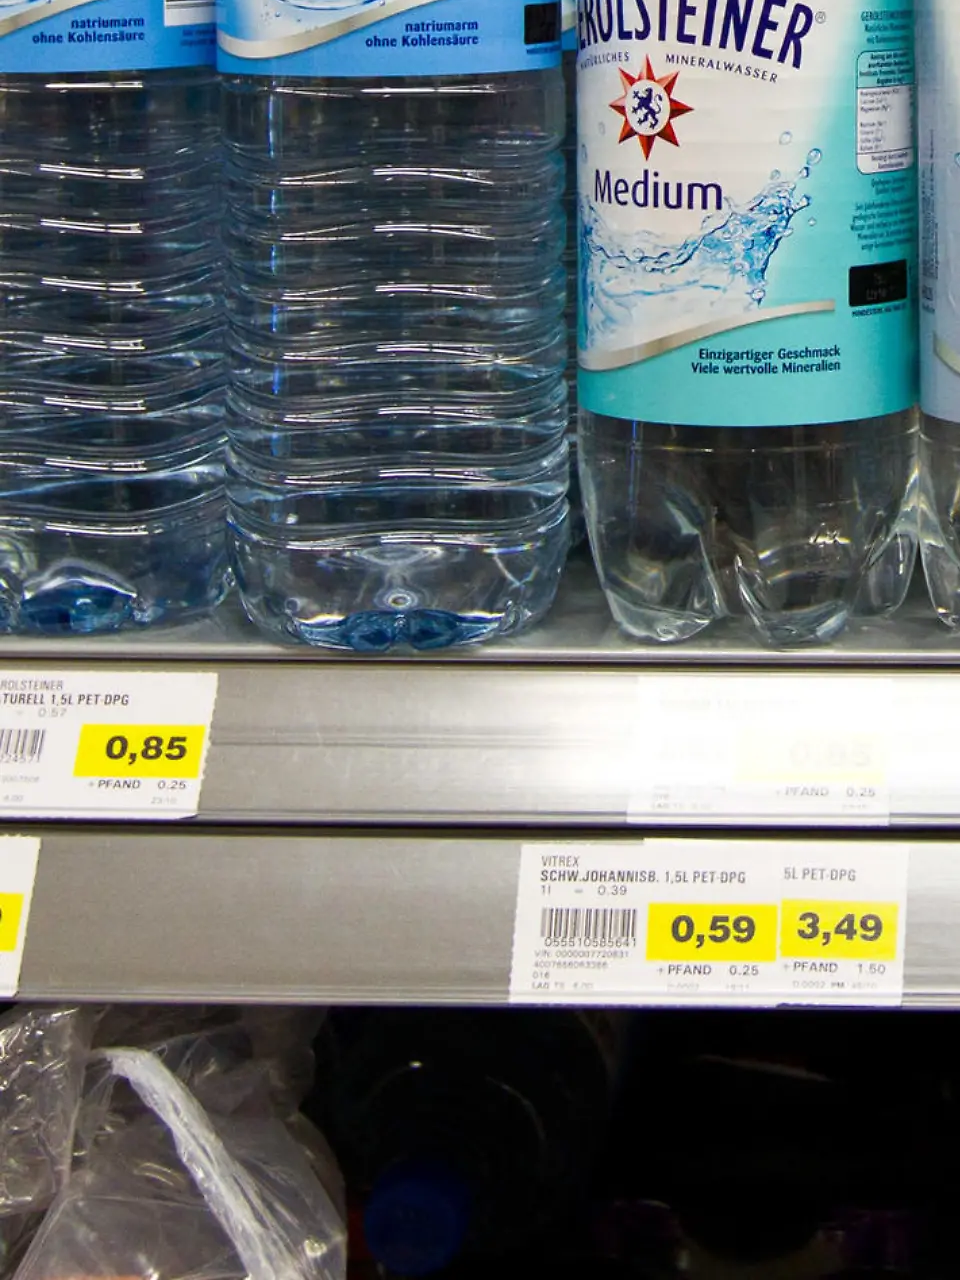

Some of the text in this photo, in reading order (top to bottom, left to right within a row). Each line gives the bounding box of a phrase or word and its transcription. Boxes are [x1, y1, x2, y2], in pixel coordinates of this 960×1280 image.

[71, 15, 145, 29] natriumarm
[404, 20, 479, 33] natriumarm
[32, 30, 145, 44] ohne Kohlensäure
[365, 34, 479, 48] ohne Kohlensäure
[665, 54, 778, 83] MINERALWASSER
[594, 170, 723, 210] Medium
[699, 345, 841, 363] Einzigartiger Geschmack
[691, 360, 841, 375] Viele wertvolle Mineralien
[105, 735, 188, 766] 0,85
[97, 780, 187, 790] PFAND 0.25
[785, 786, 876, 798] PFAND 0.25
[541, 855, 580, 867] VITREX
[540, 869, 659, 883] SCHW.JOHANNISB.
[664, 870, 689, 883] 1,5L
[597, 884, 628, 896] 0.39
[670, 914, 756, 949] 0,59
[797, 912, 884, 946] 3,49
[668, 960, 886, 976] PFAND 0.25 PFAND 1.50
